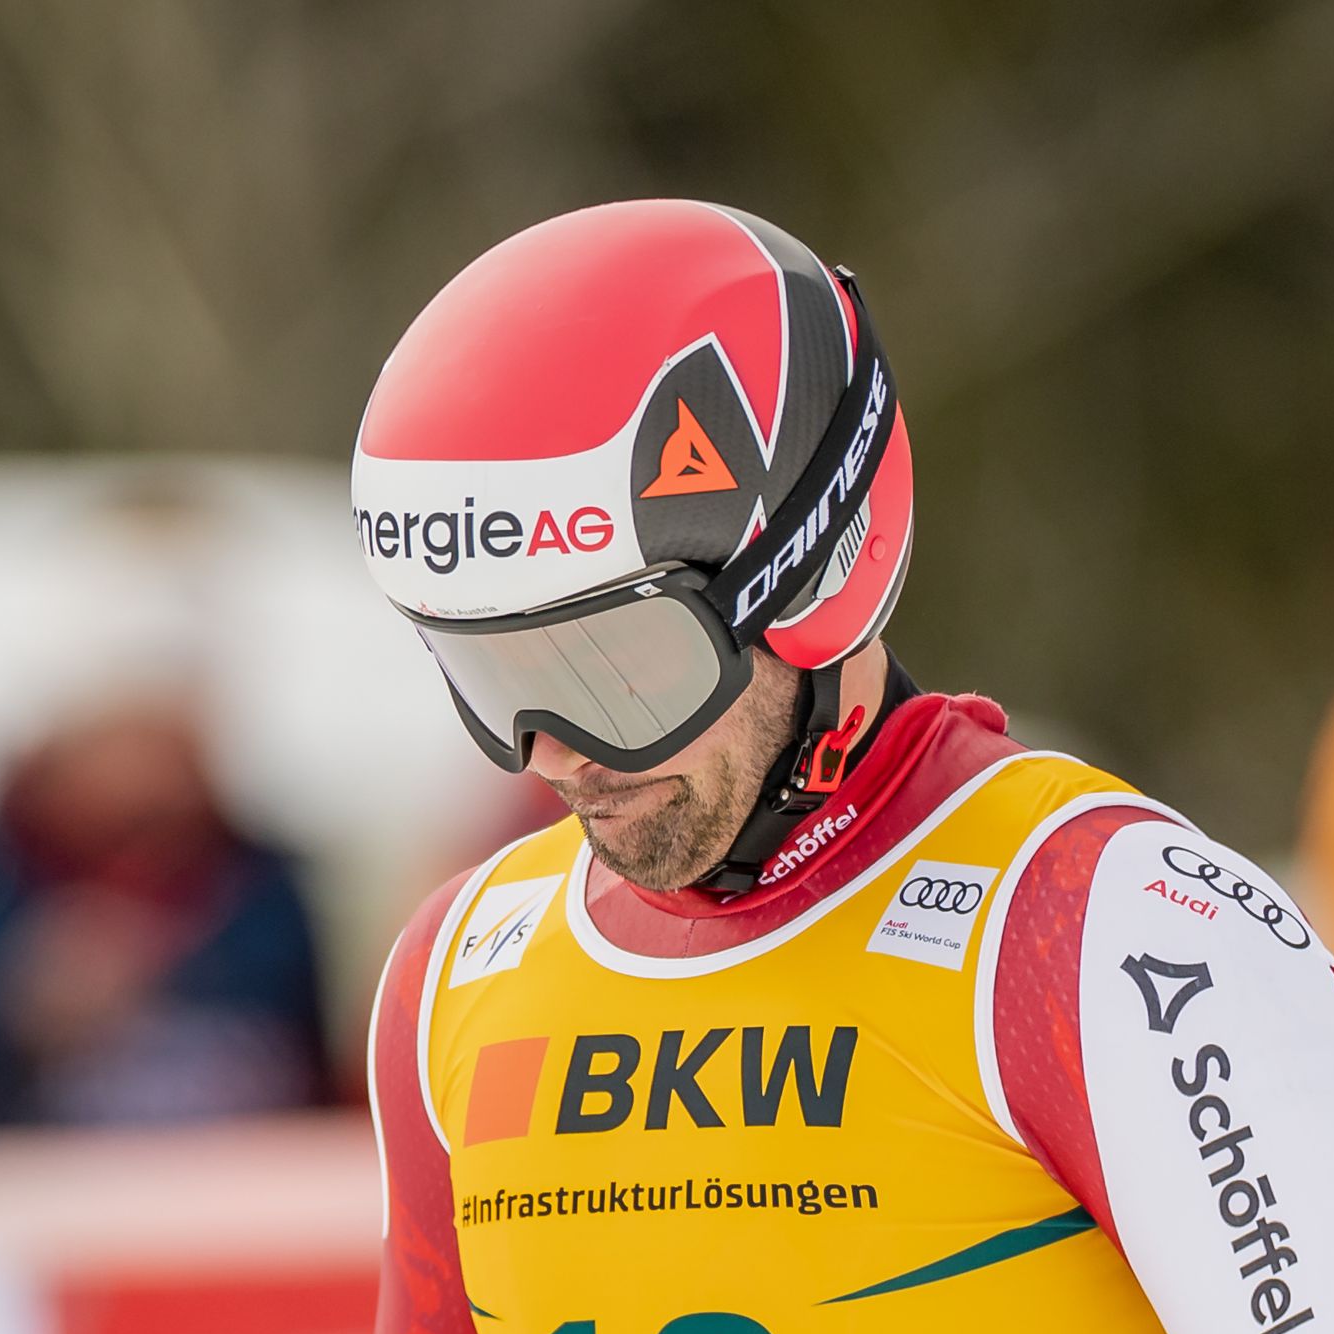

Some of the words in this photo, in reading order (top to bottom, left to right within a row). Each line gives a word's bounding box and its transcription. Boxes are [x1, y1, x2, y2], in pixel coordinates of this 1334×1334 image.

[732, 357, 887, 627] DAINESE
[353, 496, 615, 575] nergieAG
[884, 919, 909, 929] Audi
[1143, 878, 1220, 922] Audi
[462, 923, 530, 958] FIS
[880, 927, 897, 937] FIS
[898, 929, 913, 939] Ski
[914, 933, 942, 945] World
[943, 938, 962, 950] Cup
[554, 1025, 859, 1135] BKW
[462, 1177, 879, 1229] #InfrastrukturLösungen
